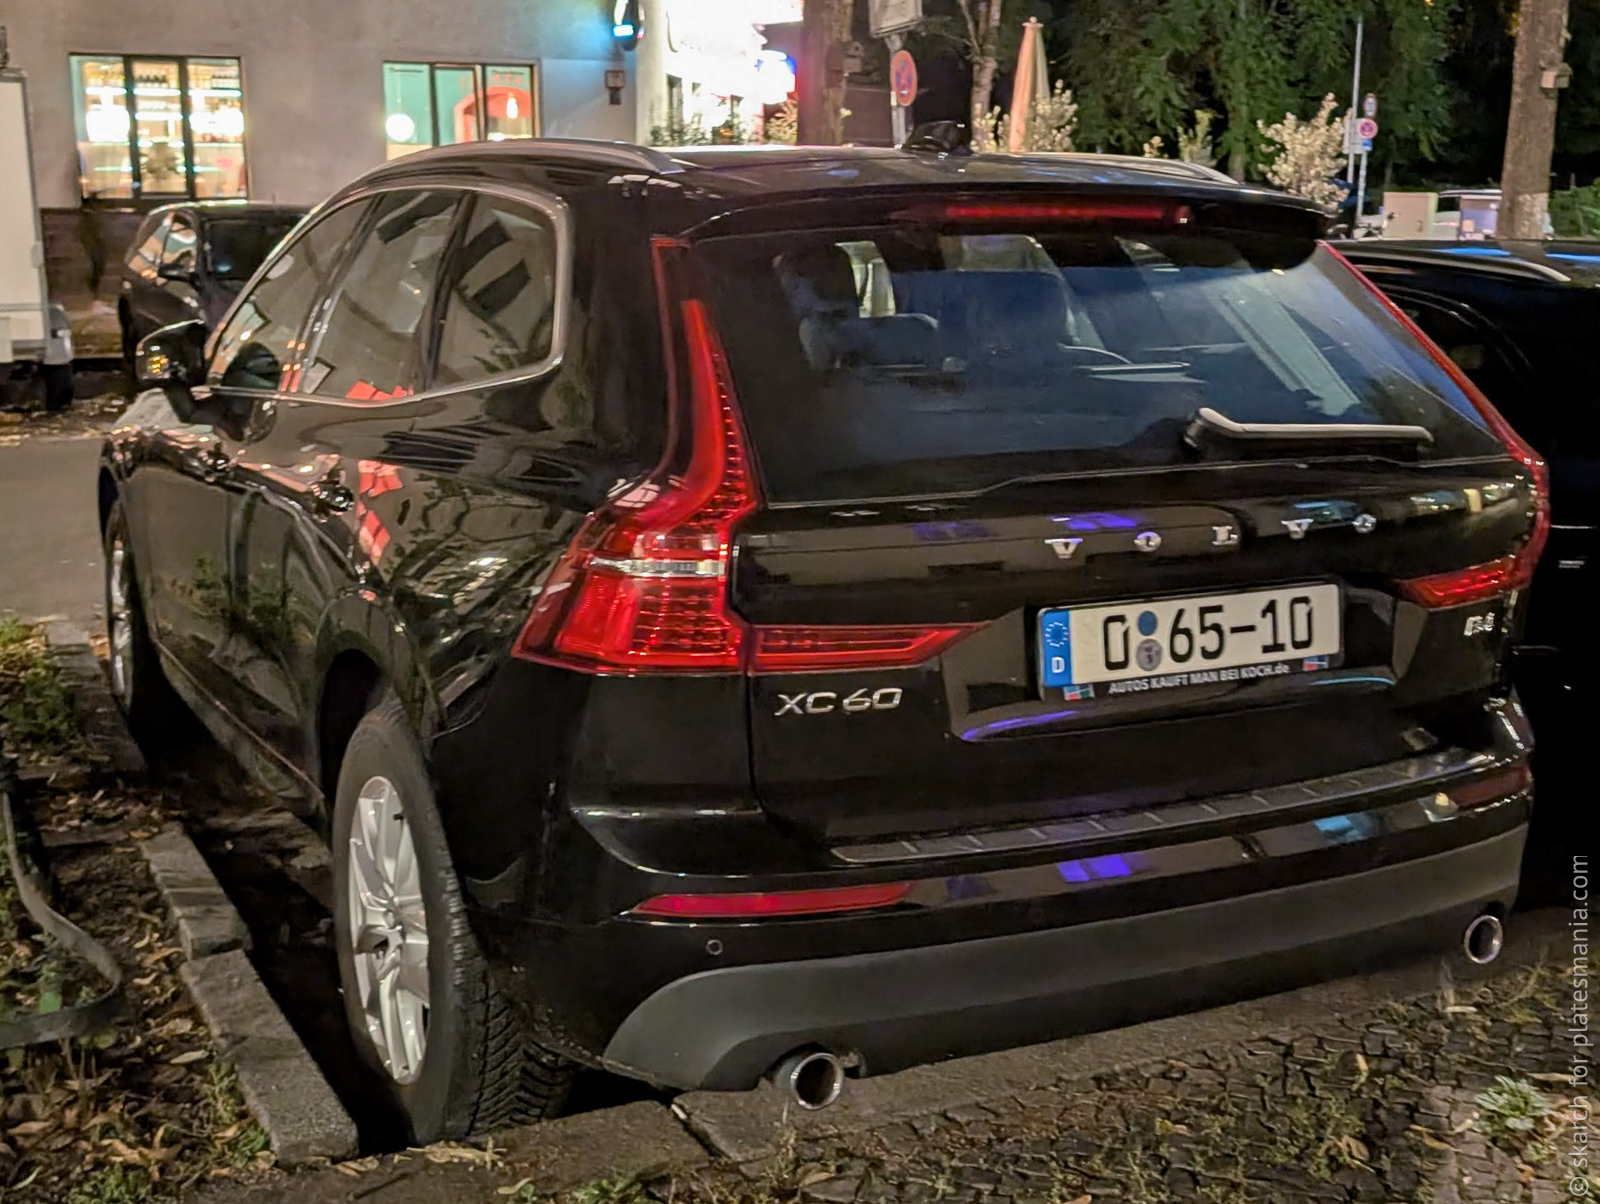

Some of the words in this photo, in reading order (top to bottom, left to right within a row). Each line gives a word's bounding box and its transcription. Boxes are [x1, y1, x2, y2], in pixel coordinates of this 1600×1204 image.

[1044, 513, 1377, 559] VOLVO
[1103, 614, 1130, 671] 0
[1168, 596, 1314, 663] 65-10
[1051, 656, 1065, 673] D
[1108, 679, 1150, 694] AUTOS
[1150, 674, 1189, 689] KAUFT
[1190, 671, 1219, 685] MAN
[1220, 667, 1239, 681] BEI
